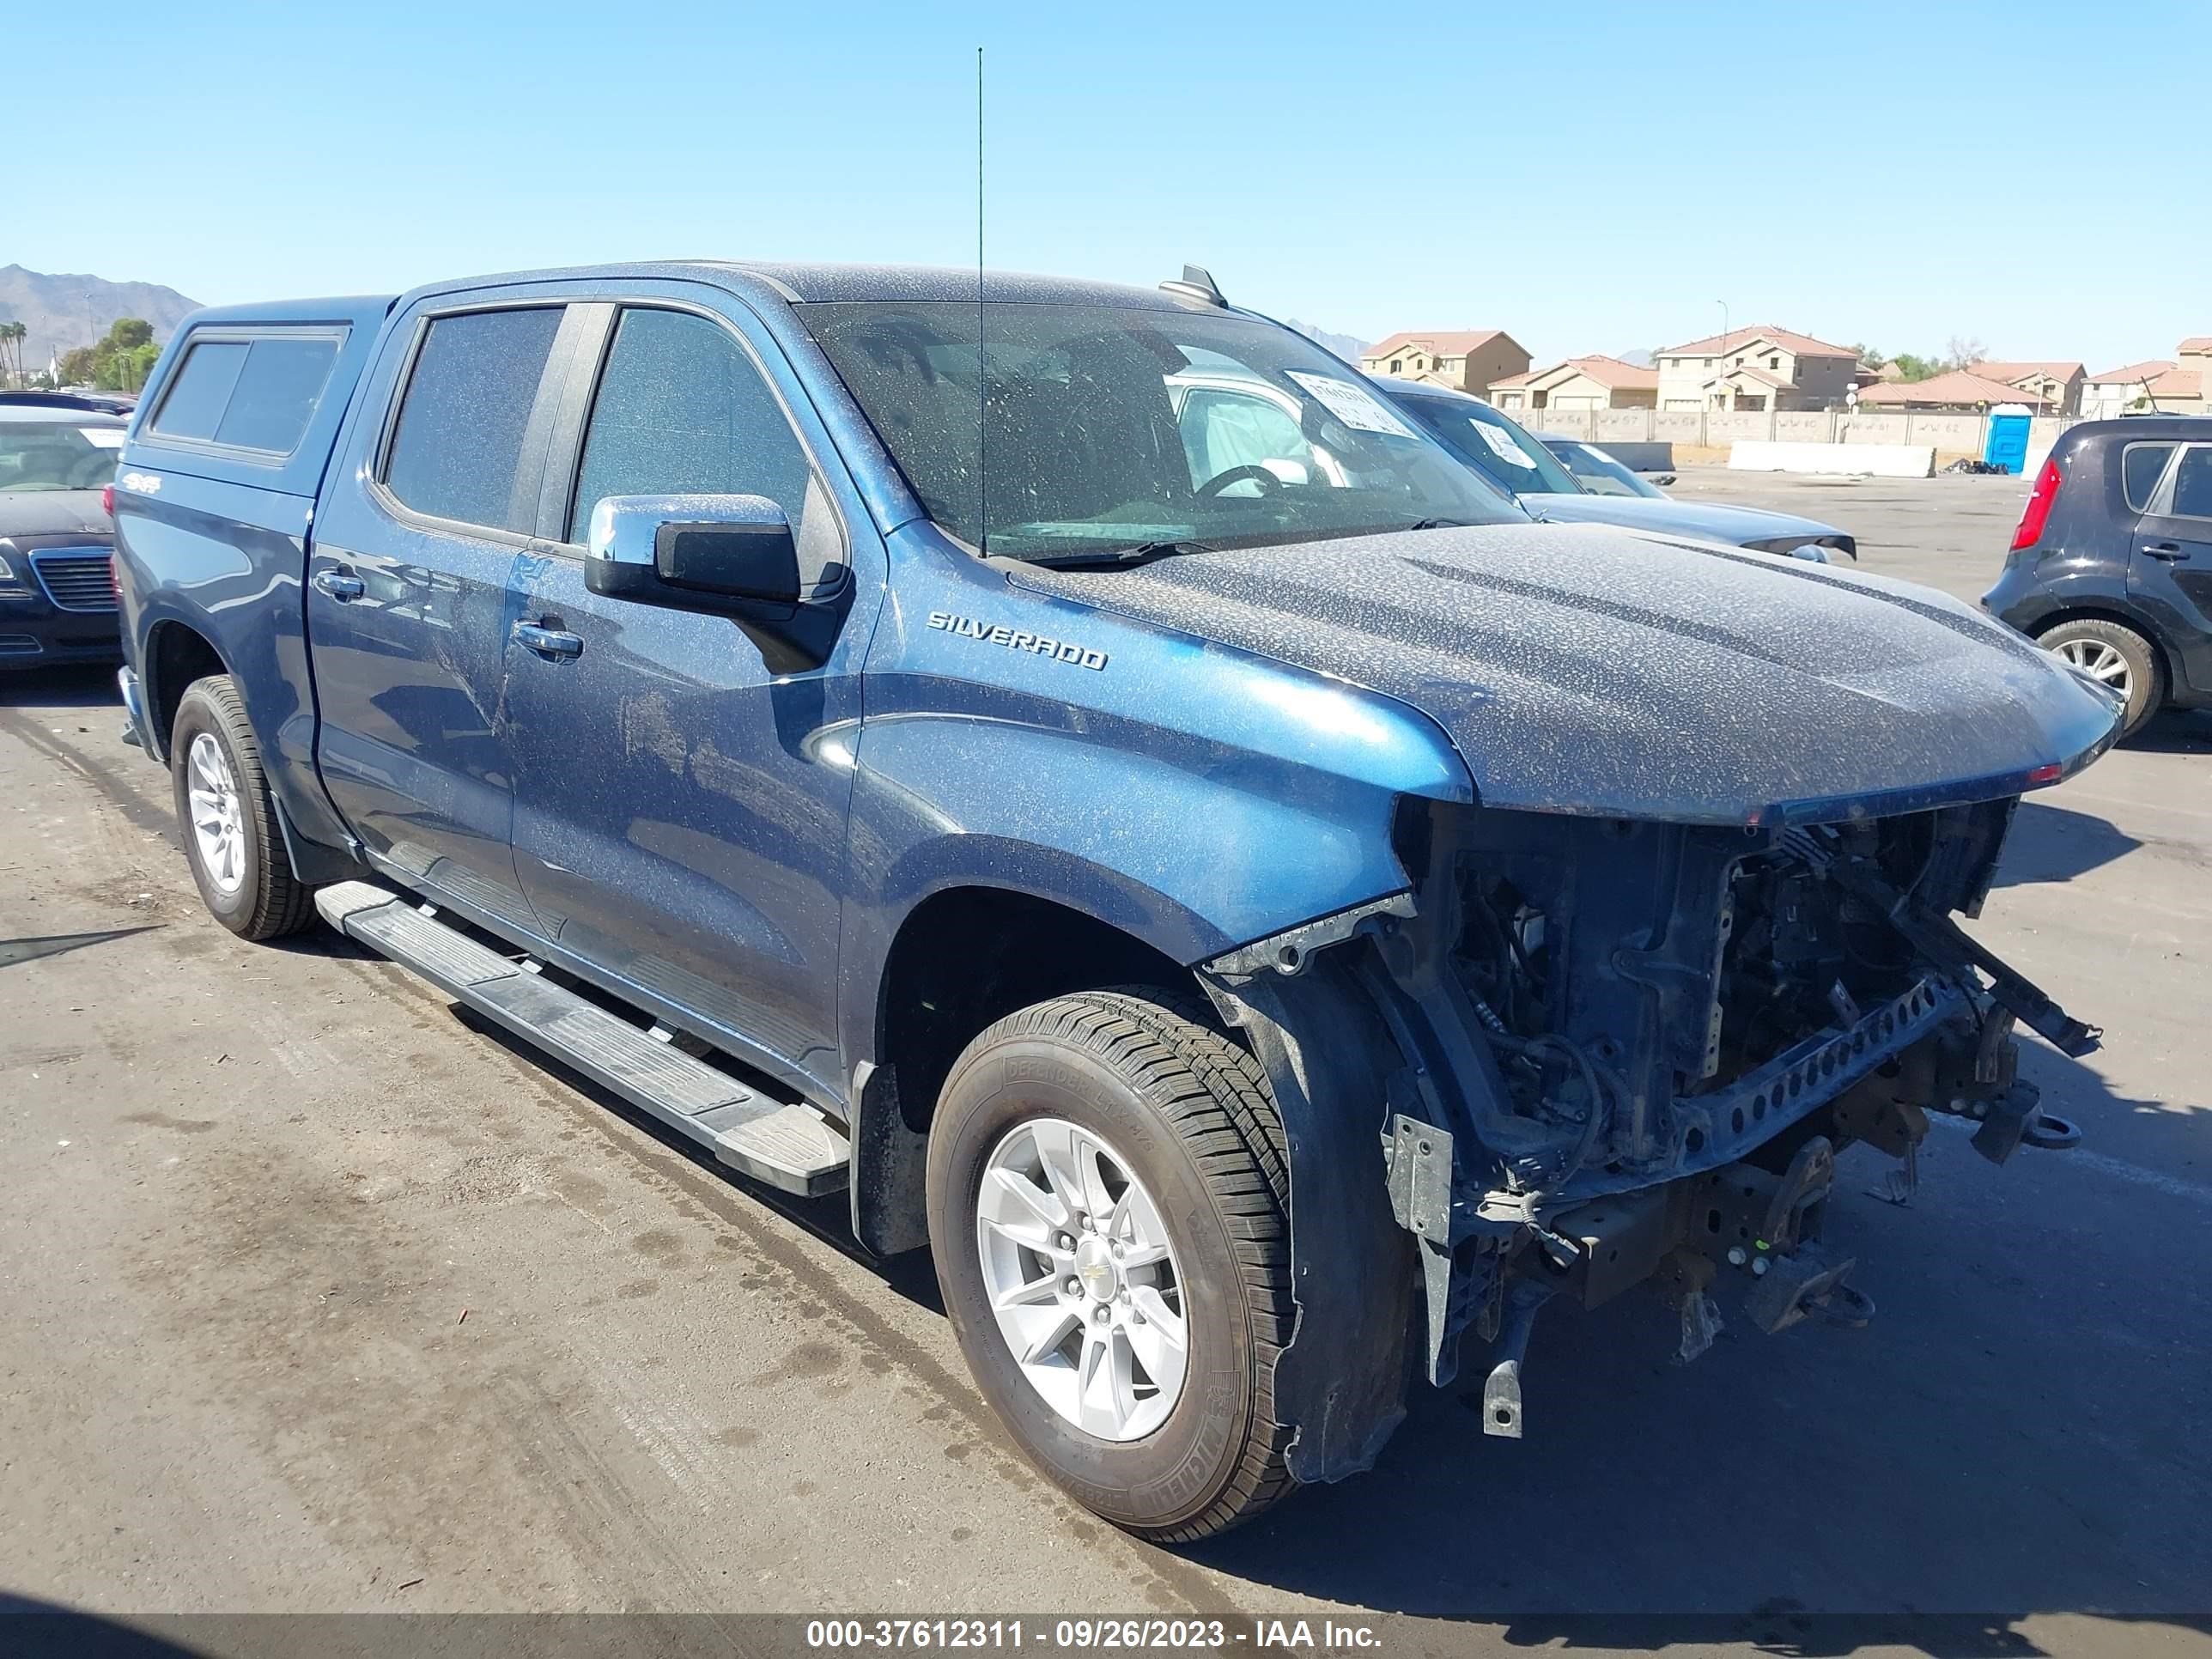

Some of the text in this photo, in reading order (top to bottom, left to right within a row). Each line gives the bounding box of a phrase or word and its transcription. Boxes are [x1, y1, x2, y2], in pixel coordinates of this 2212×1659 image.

[926, 611, 1110, 672] SILVERADO
[1008, 1060, 1091, 1093] DEFENDER
[1137, 1419, 1226, 1515] MICHELIN
